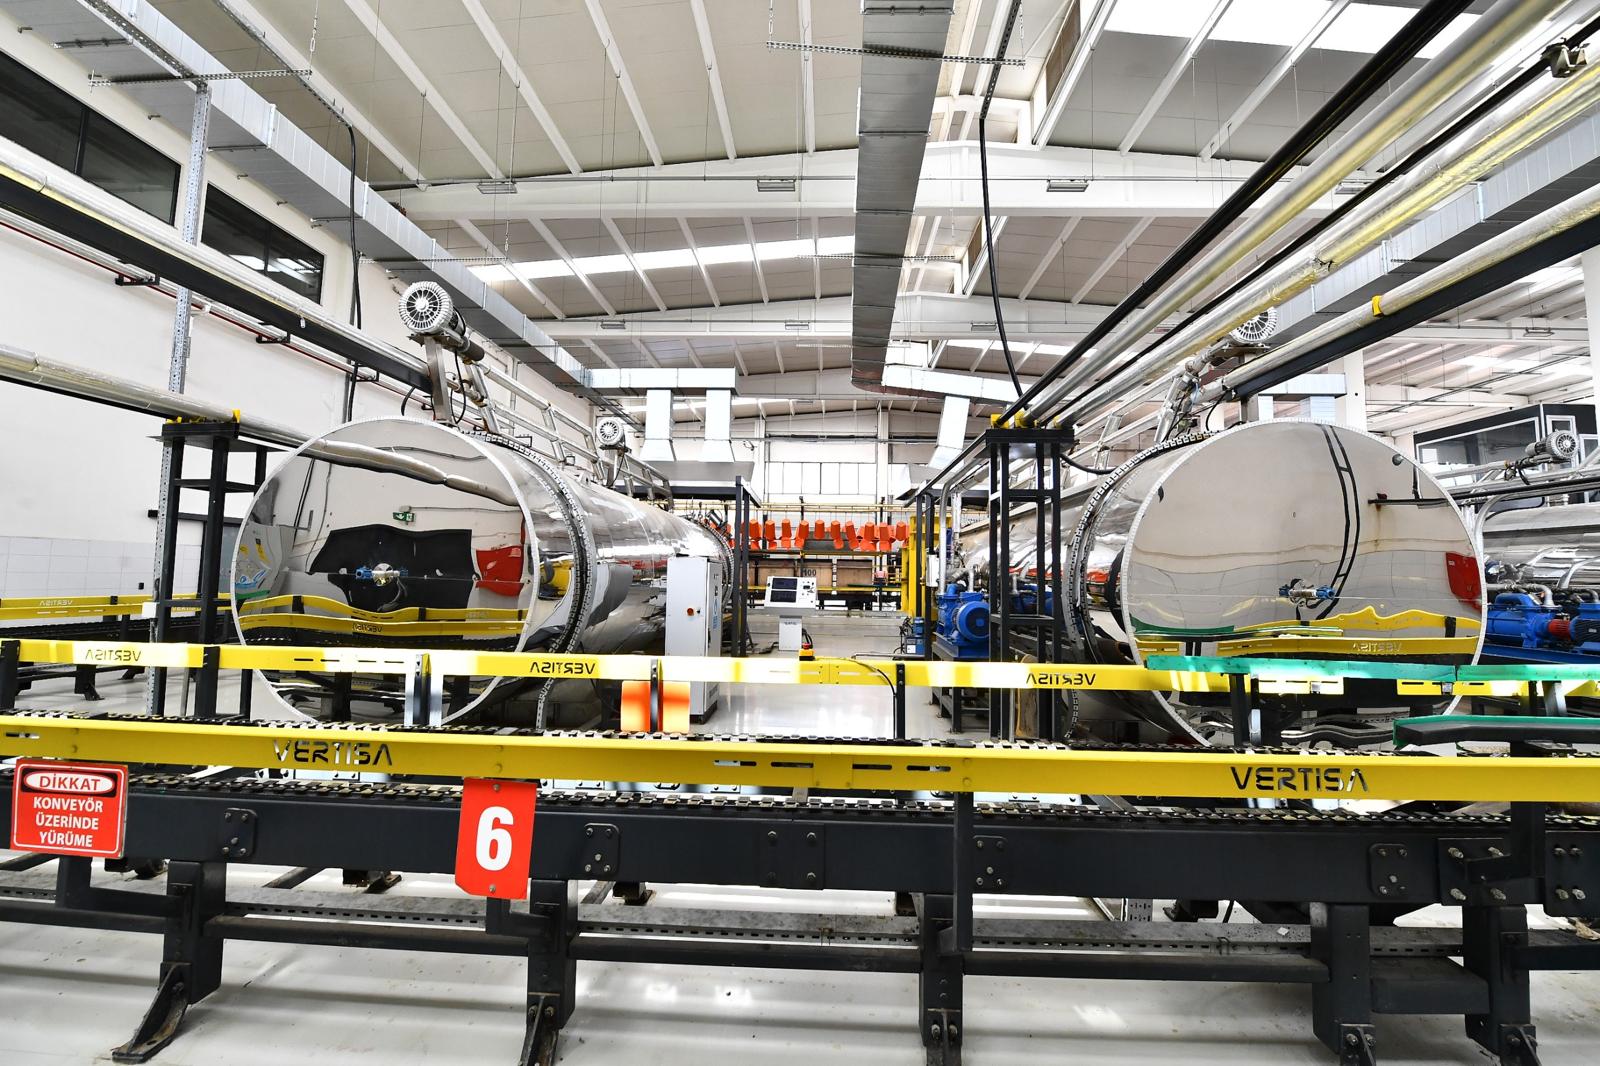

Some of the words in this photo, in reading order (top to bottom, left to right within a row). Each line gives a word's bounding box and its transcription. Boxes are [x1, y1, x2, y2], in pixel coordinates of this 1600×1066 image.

[274, 740, 392, 766] VERTISA
[40, 774, 100, 790] DİKKAT
[1231, 767, 1368, 791] VERTISA
[33, 796, 103, 813] KONVEYÖR
[35, 812, 99, 830] ÜZERİNDE
[39, 830, 93, 847] YÜRÜME
[476, 806, 514, 871] 6
